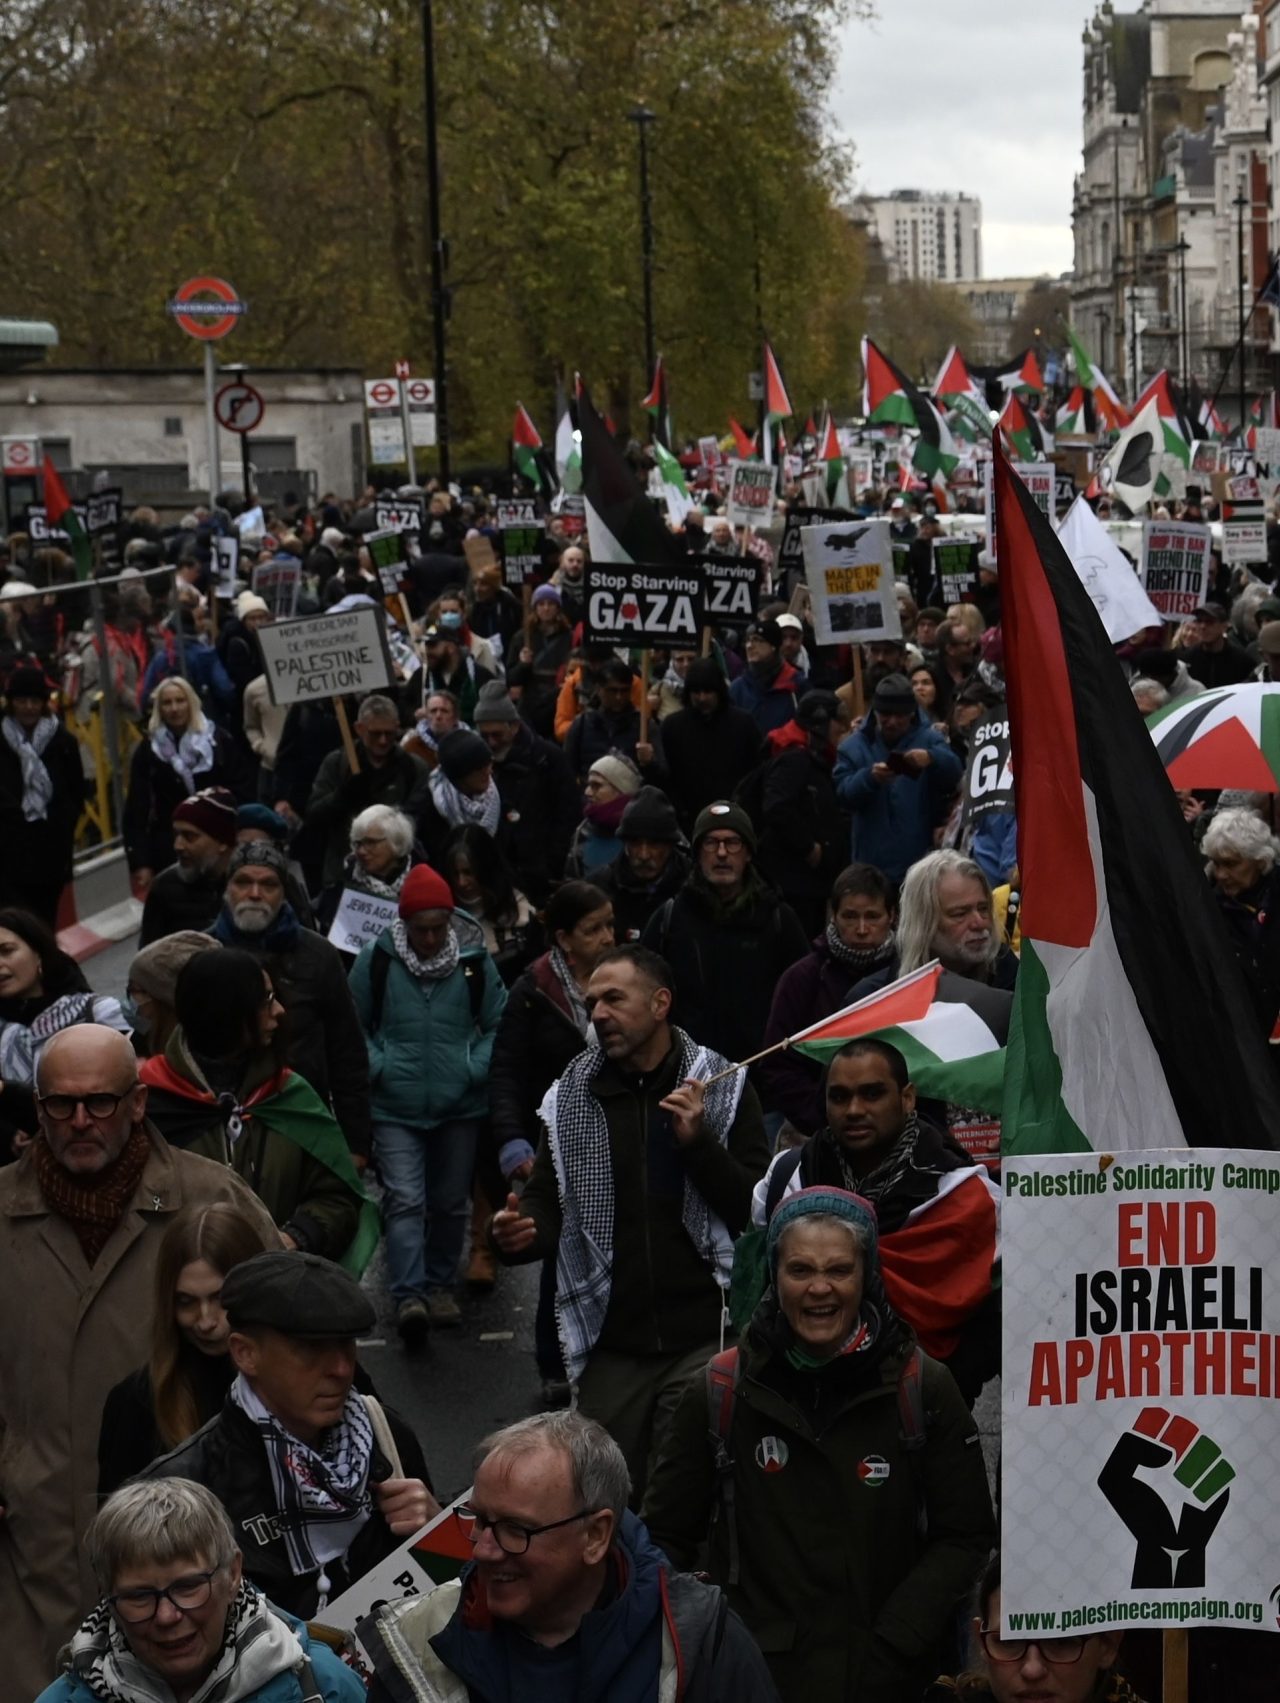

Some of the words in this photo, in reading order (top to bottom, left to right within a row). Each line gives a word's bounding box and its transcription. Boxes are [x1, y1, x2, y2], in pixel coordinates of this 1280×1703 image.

[1055, 482, 1075, 500] ZA
[590, 572, 627, 590] Stop
[631, 574, 699, 595] Starving
[703, 563, 756, 581] Starving
[825, 567, 861, 580] MADE
[865, 565, 880, 578] IN
[1146, 569, 1185, 591] RIGHT
[1186, 571, 1203, 593] TO
[704, 580, 753, 614] ZA
[827, 581, 853, 593] THE
[857, 580, 875, 592] UK
[589, 591, 697, 634] GAZA
[275, 646, 373, 677] PALESTINE
[297, 668, 363, 695] ACTION
[346, 898, 373, 914] JEWS
[373, 904, 398, 921] AGAI
[361, 920, 385, 937] GAZ
[1006, 1168, 1107, 1197] Palestine
[1113, 1162, 1215, 1192] Solidarity
[1117, 1201, 1216, 1268] END
[1075, 1265, 1263, 1338] ISRAELI
[1009, 1597, 1263, 1632] www.palestinecampaign.org
